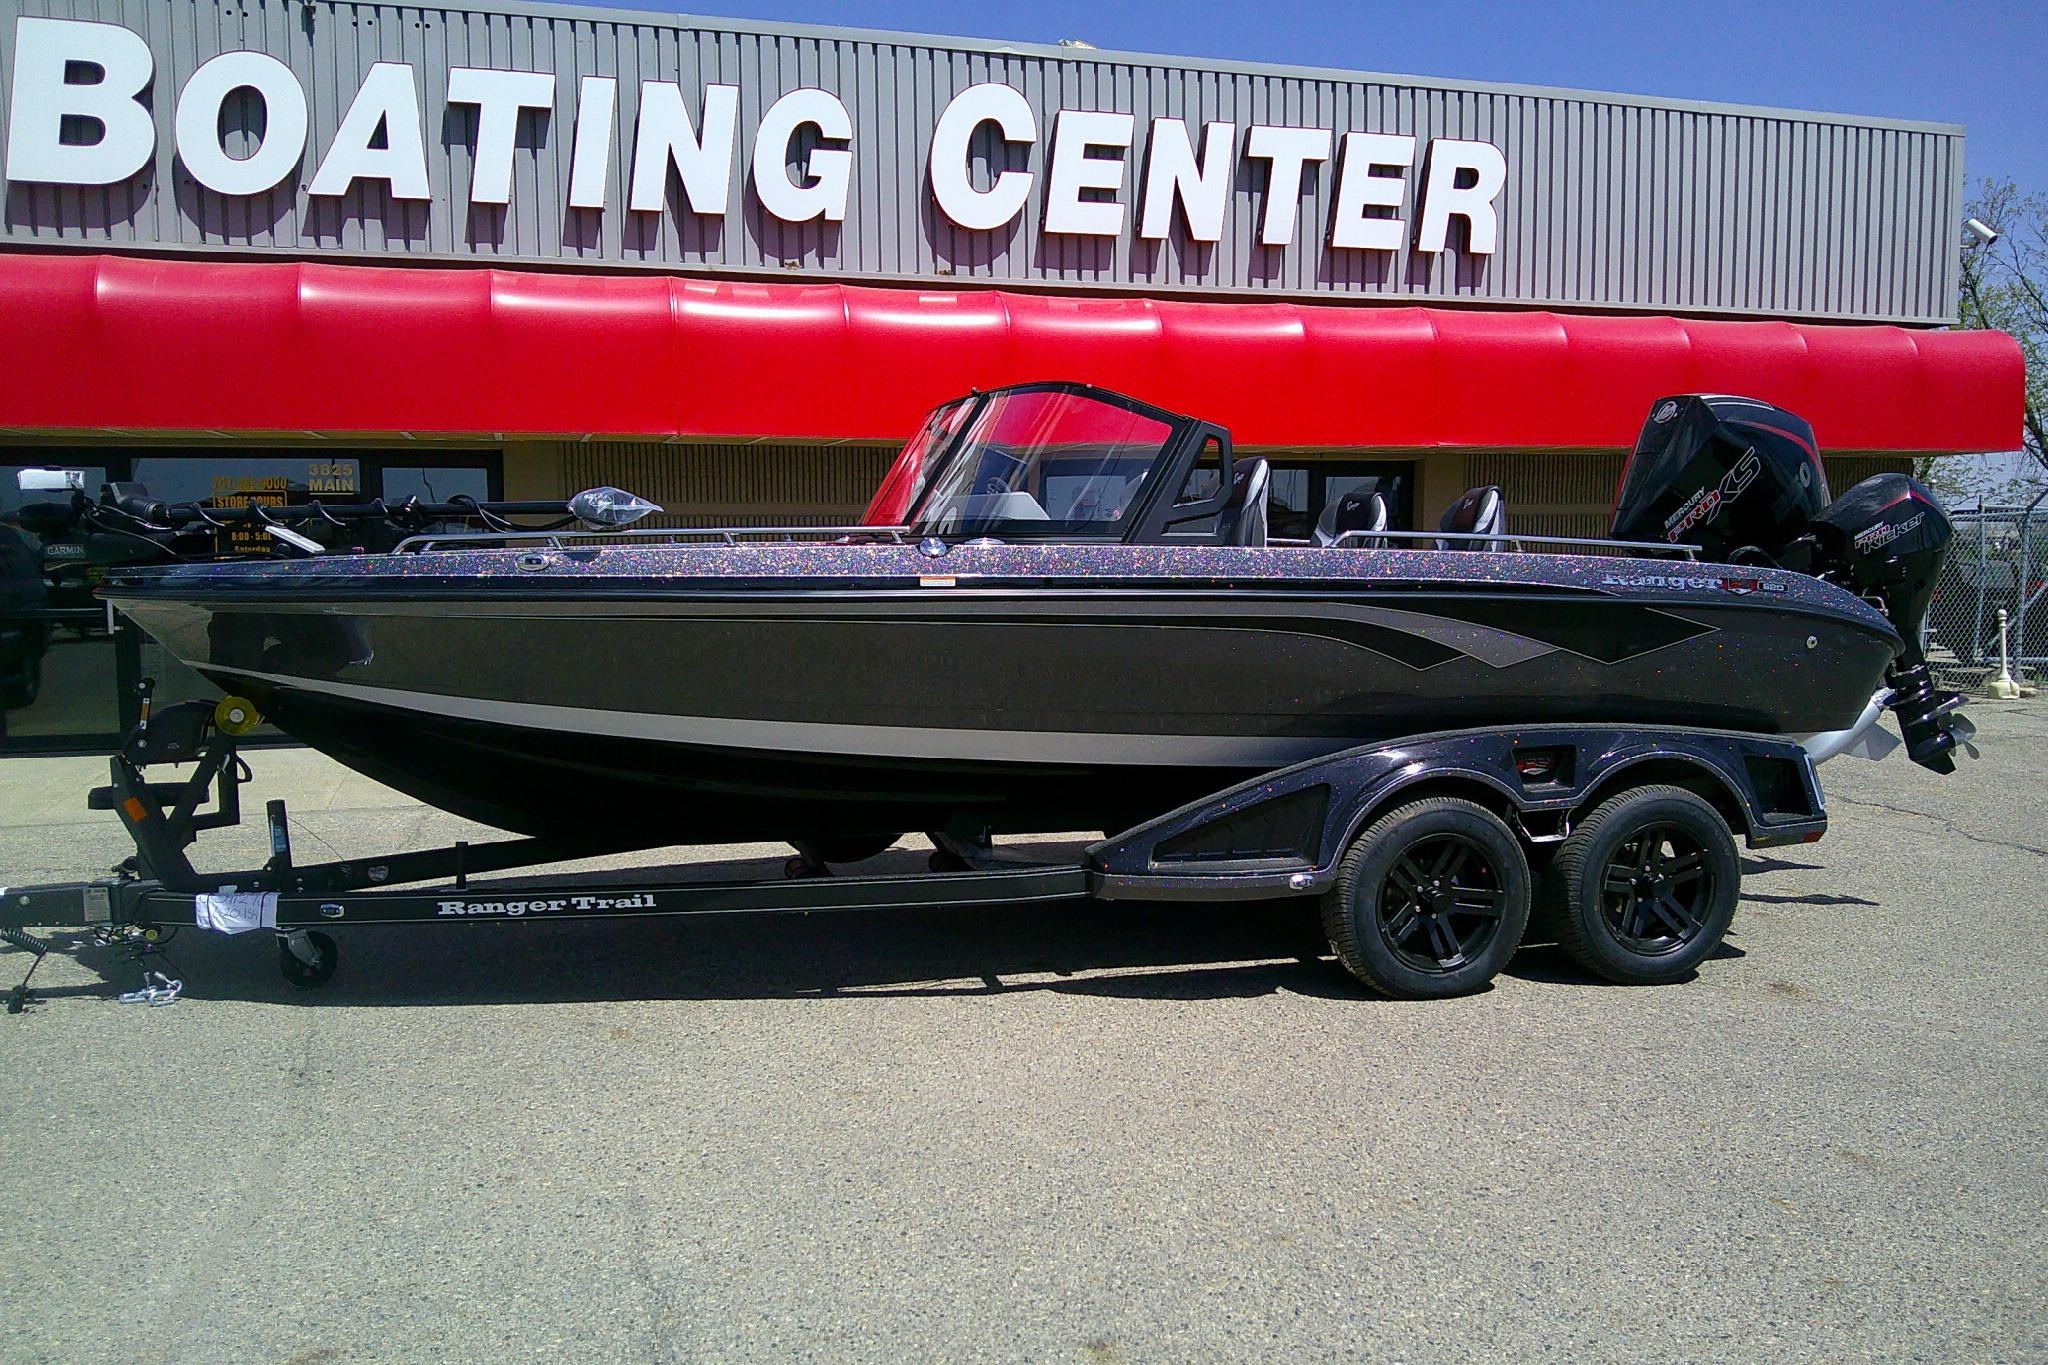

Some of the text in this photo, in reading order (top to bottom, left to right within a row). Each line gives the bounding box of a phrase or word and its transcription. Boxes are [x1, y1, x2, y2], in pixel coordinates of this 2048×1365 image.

[5, 15, 1507, 255] BOATING CENTER
[309, 464, 353, 476] 3825
[309, 479, 354, 491] MAIN
[217, 496, 284, 508] STORE OURS
[1663, 486, 1705, 529] MERCURY
[1854, 520, 1884, 541] MERCURY
[47, 545, 84, 556] GARMIN
[436, 893, 657, 917] Ranger Trail
